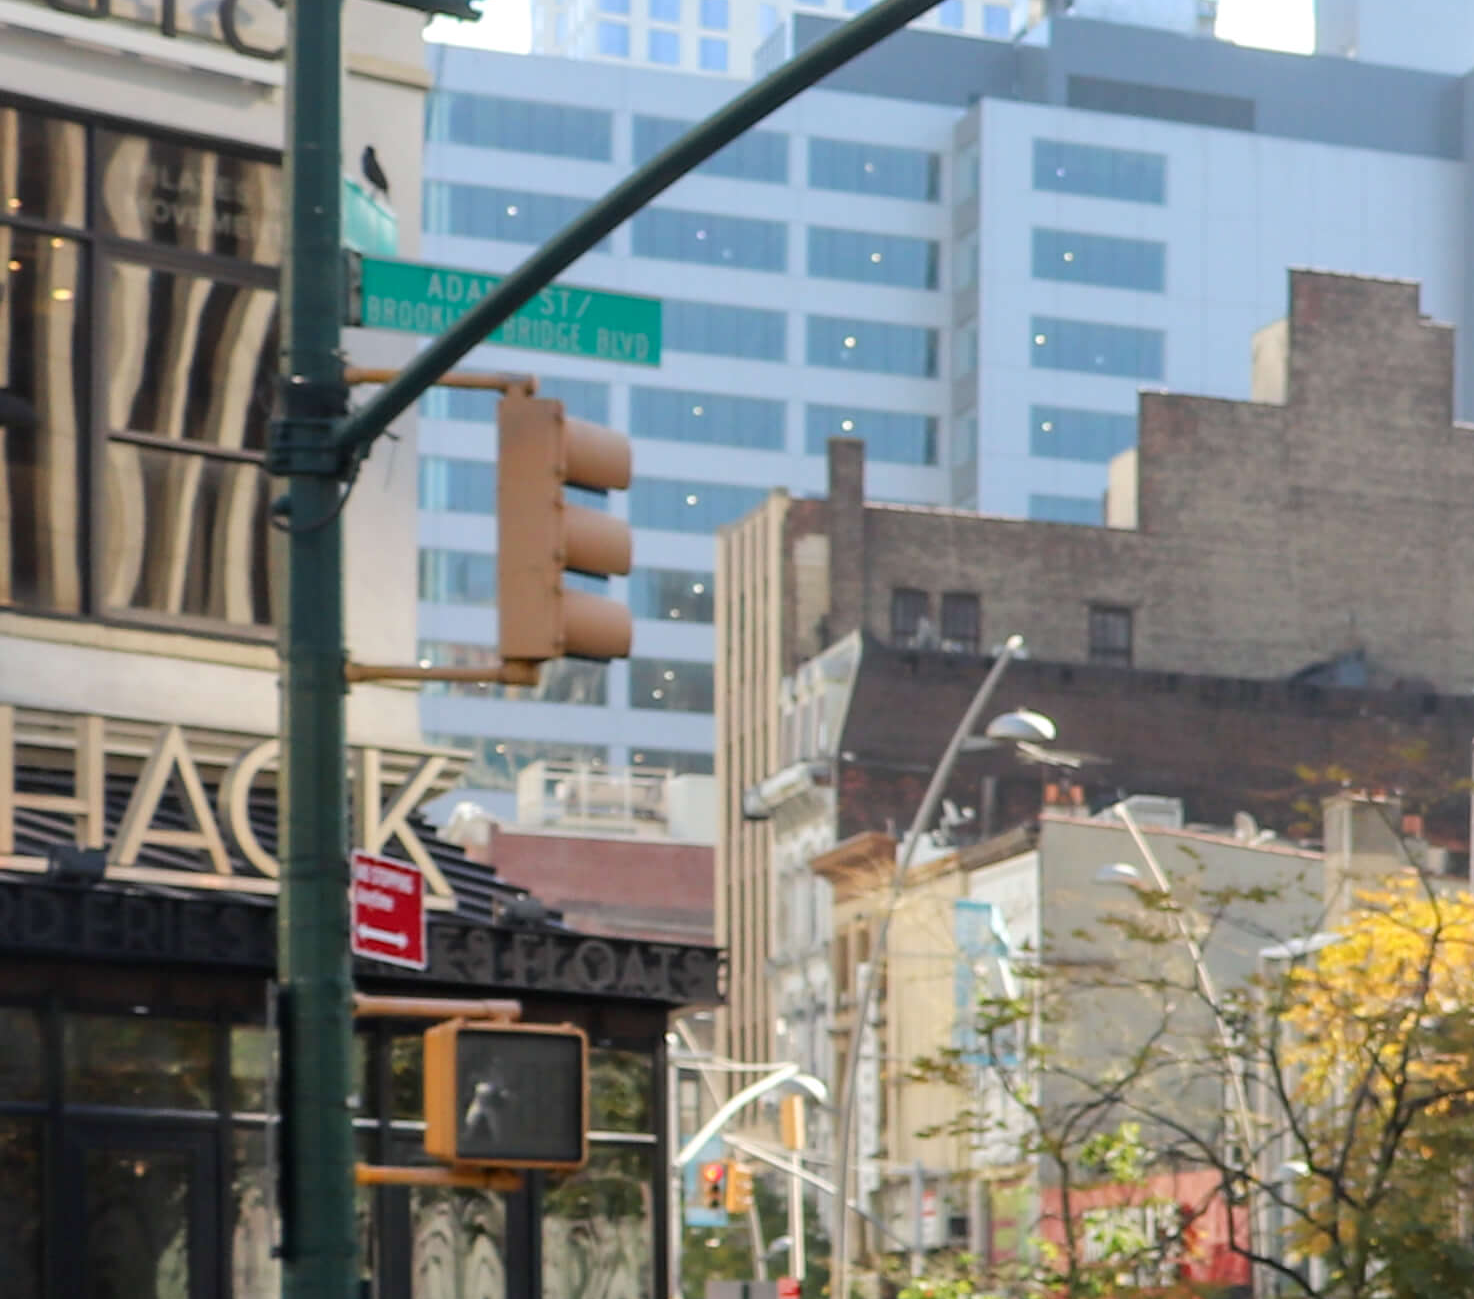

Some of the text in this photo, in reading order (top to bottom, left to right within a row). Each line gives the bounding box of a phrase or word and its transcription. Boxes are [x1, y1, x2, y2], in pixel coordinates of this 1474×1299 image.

[366, 295, 649, 360] BROOKL BRIDGE BLVD
[511, 932, 705, 998] FLOATS
